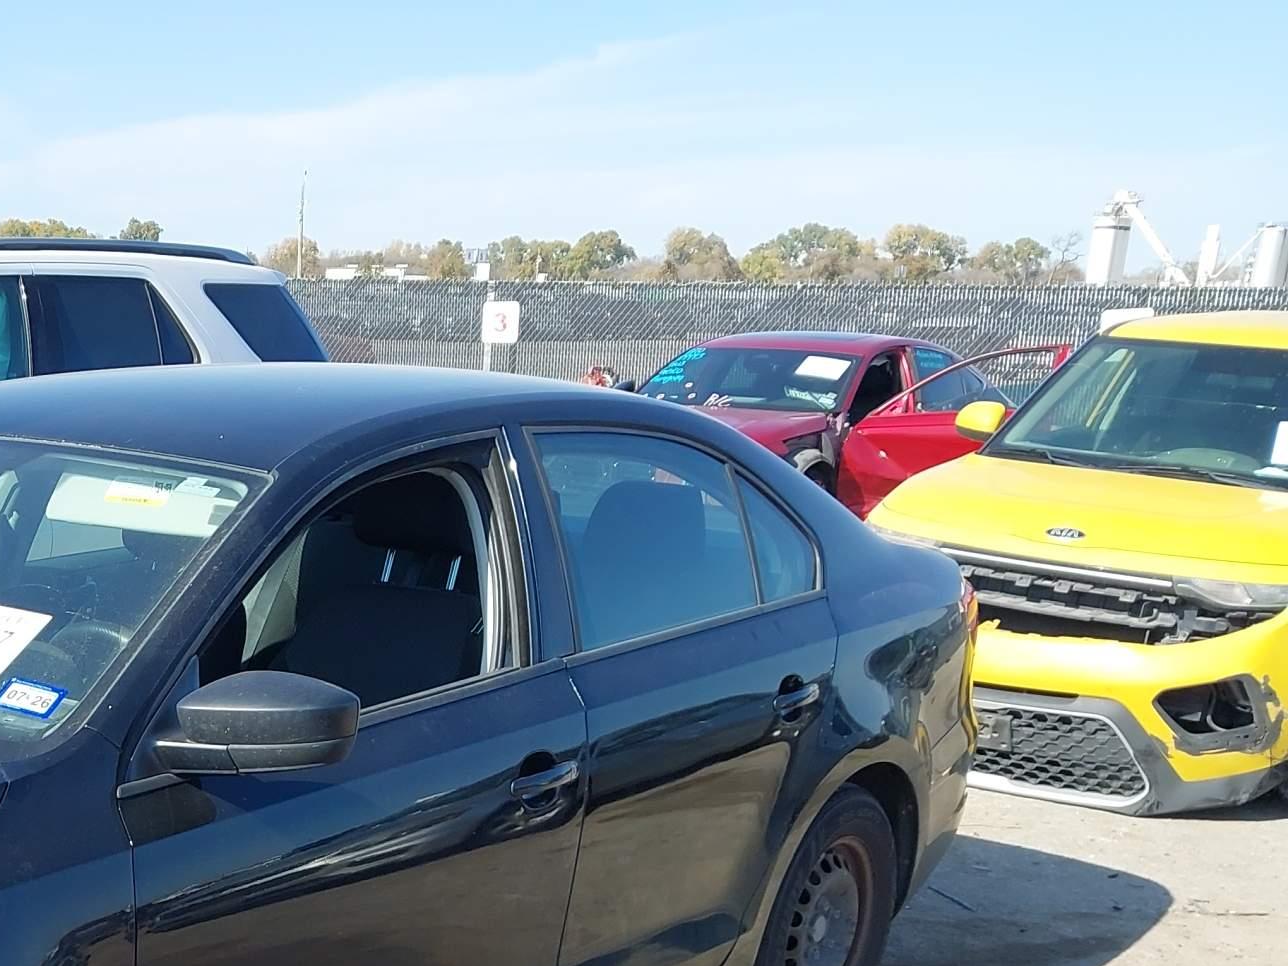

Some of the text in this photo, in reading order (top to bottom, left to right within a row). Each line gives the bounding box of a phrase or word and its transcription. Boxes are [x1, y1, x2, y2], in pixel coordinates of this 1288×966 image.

[494, 313, 507, 332] 3
[1049, 527, 1082, 538] KIA
[6, 689, 52, 709] 07 26
